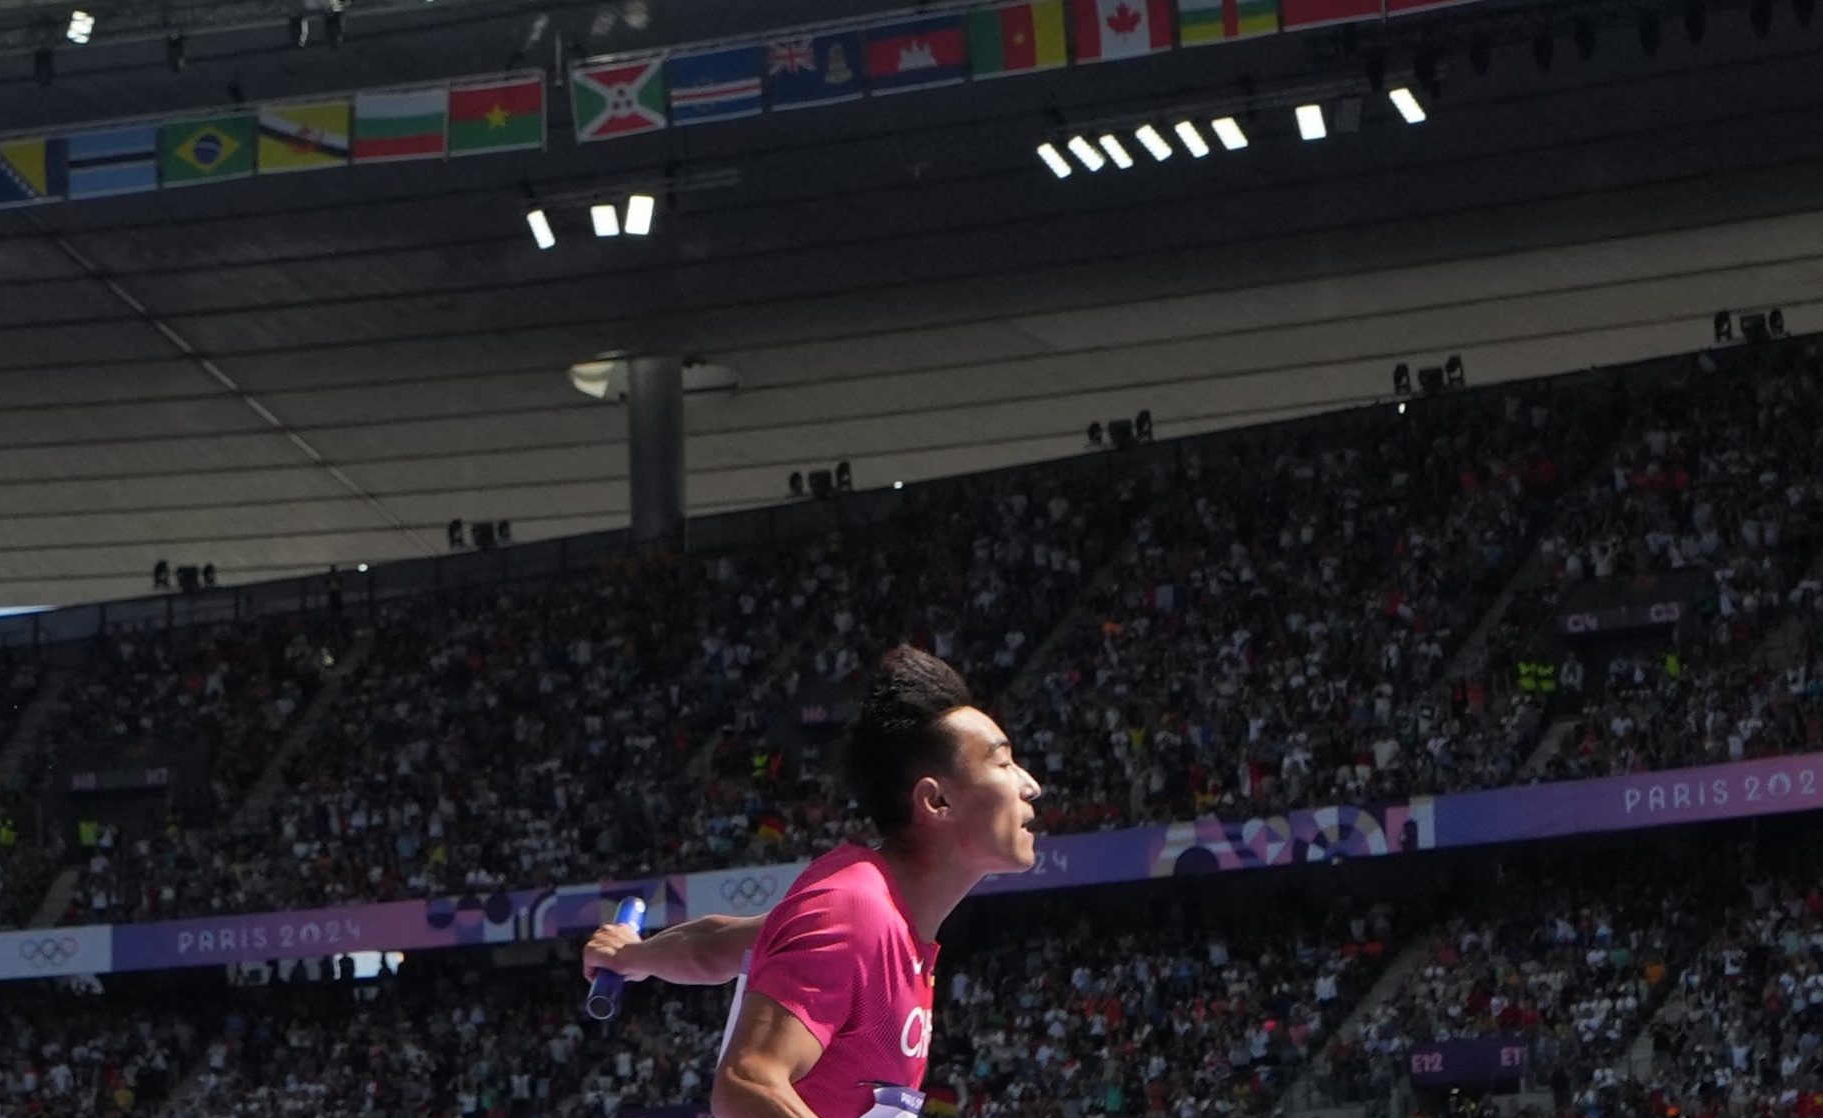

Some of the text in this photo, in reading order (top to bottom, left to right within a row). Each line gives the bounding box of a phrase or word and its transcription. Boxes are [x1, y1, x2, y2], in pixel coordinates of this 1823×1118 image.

[1625, 769, 1815, 814] PARIS 202
[178, 918, 362, 953] PARIS 2024
